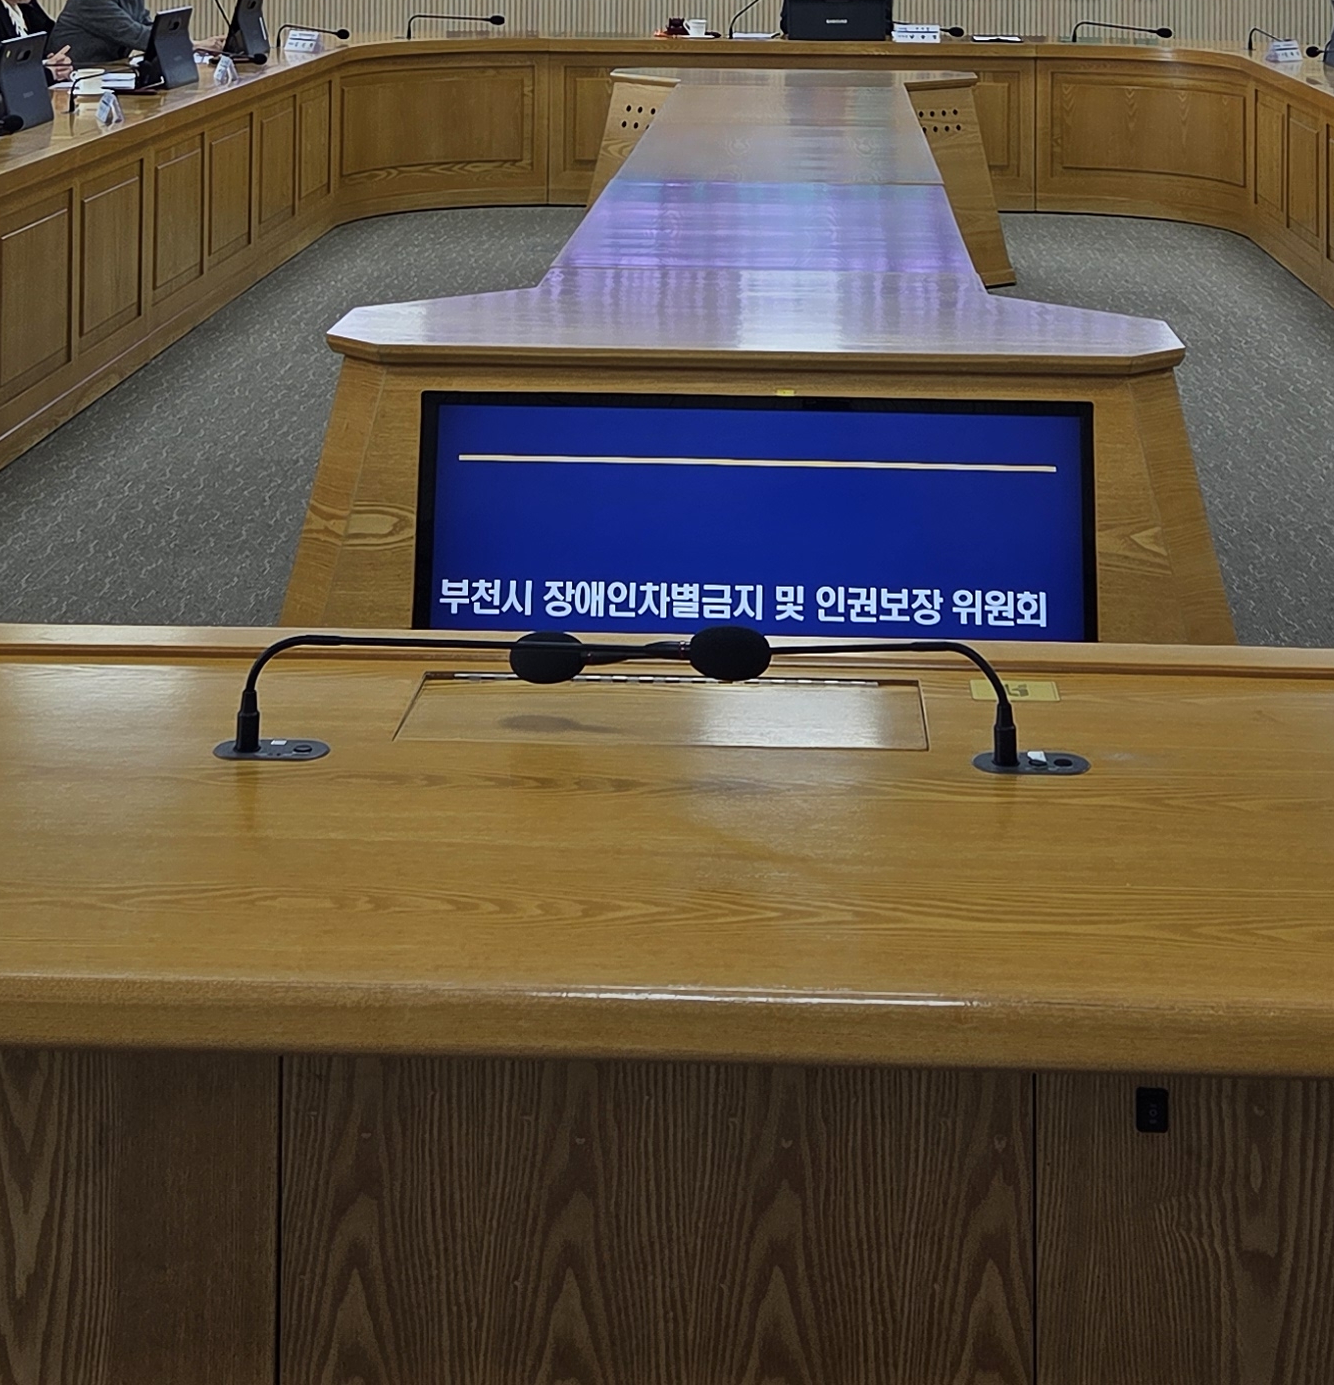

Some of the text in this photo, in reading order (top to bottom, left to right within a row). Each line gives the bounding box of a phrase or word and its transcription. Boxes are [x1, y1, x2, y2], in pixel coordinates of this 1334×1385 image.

[439, 579, 1047, 628] 부천시 장애인차별금지 및 인권보장 위원회
